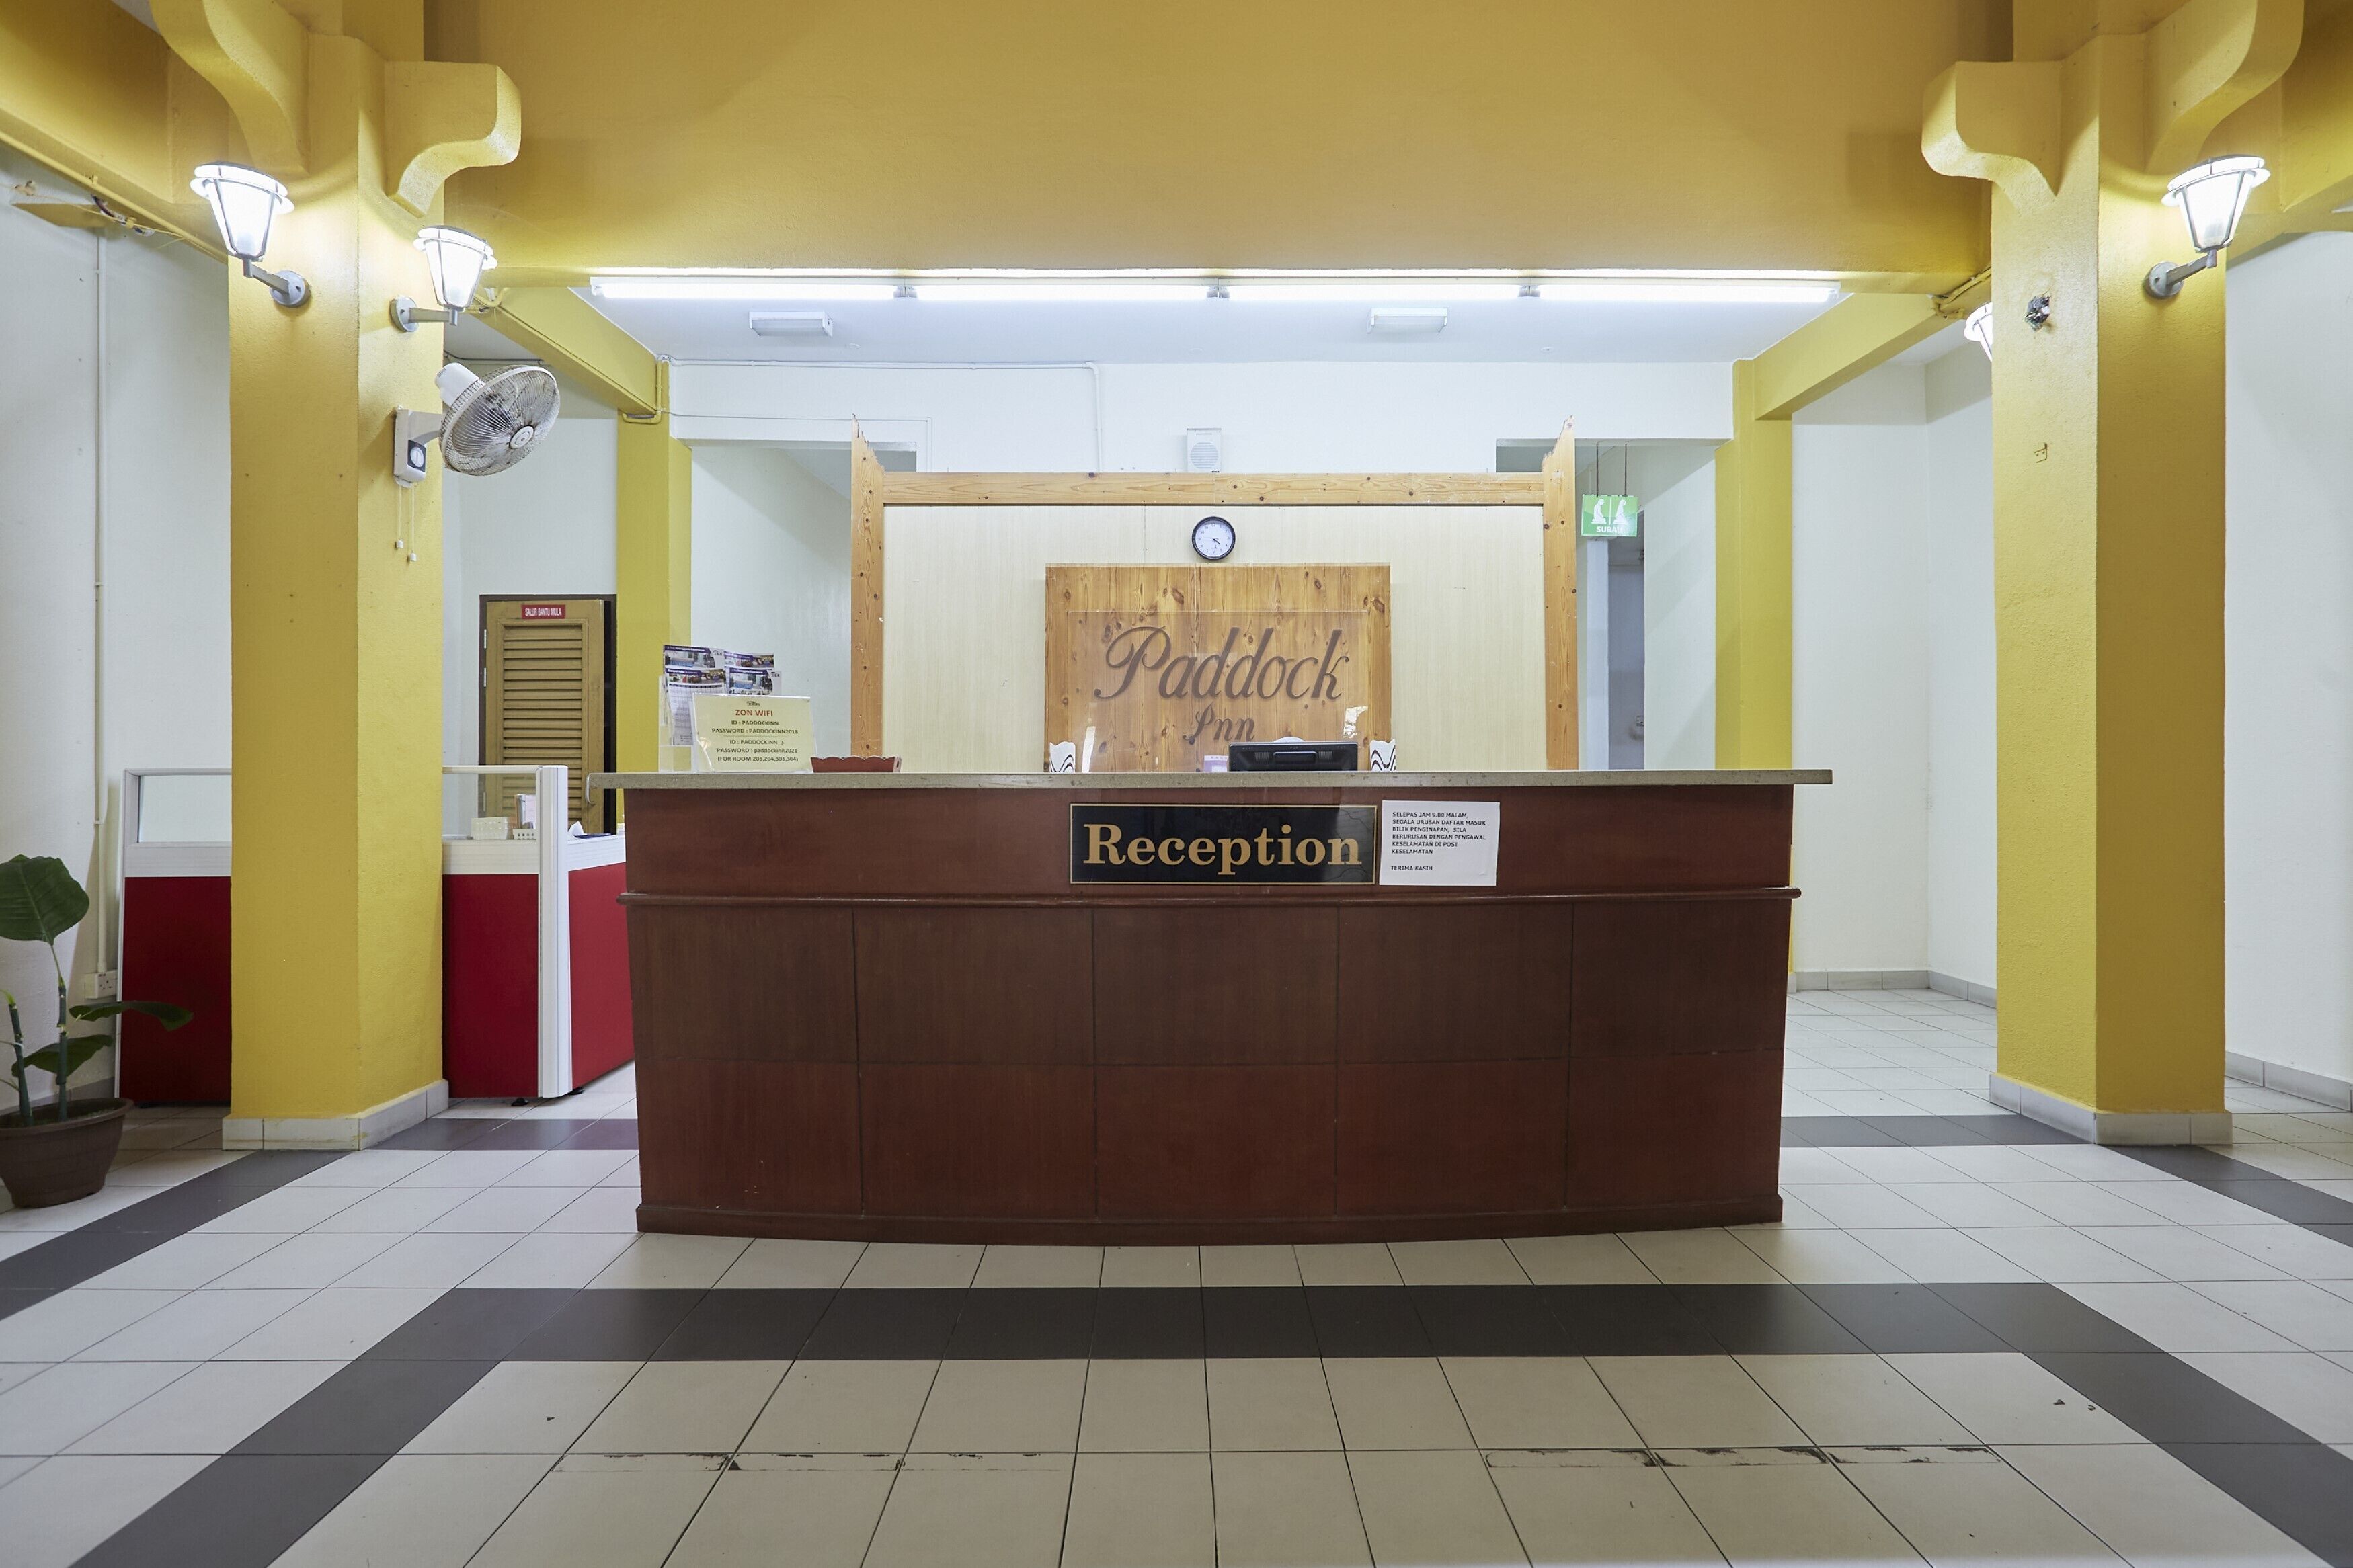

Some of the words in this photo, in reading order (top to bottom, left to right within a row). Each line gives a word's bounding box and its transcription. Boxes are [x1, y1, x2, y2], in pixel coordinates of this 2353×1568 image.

[1094, 626, 1350, 700] Paddock
[1183, 702, 1254, 745] Inn
[1083, 824, 1362, 876] Reception
